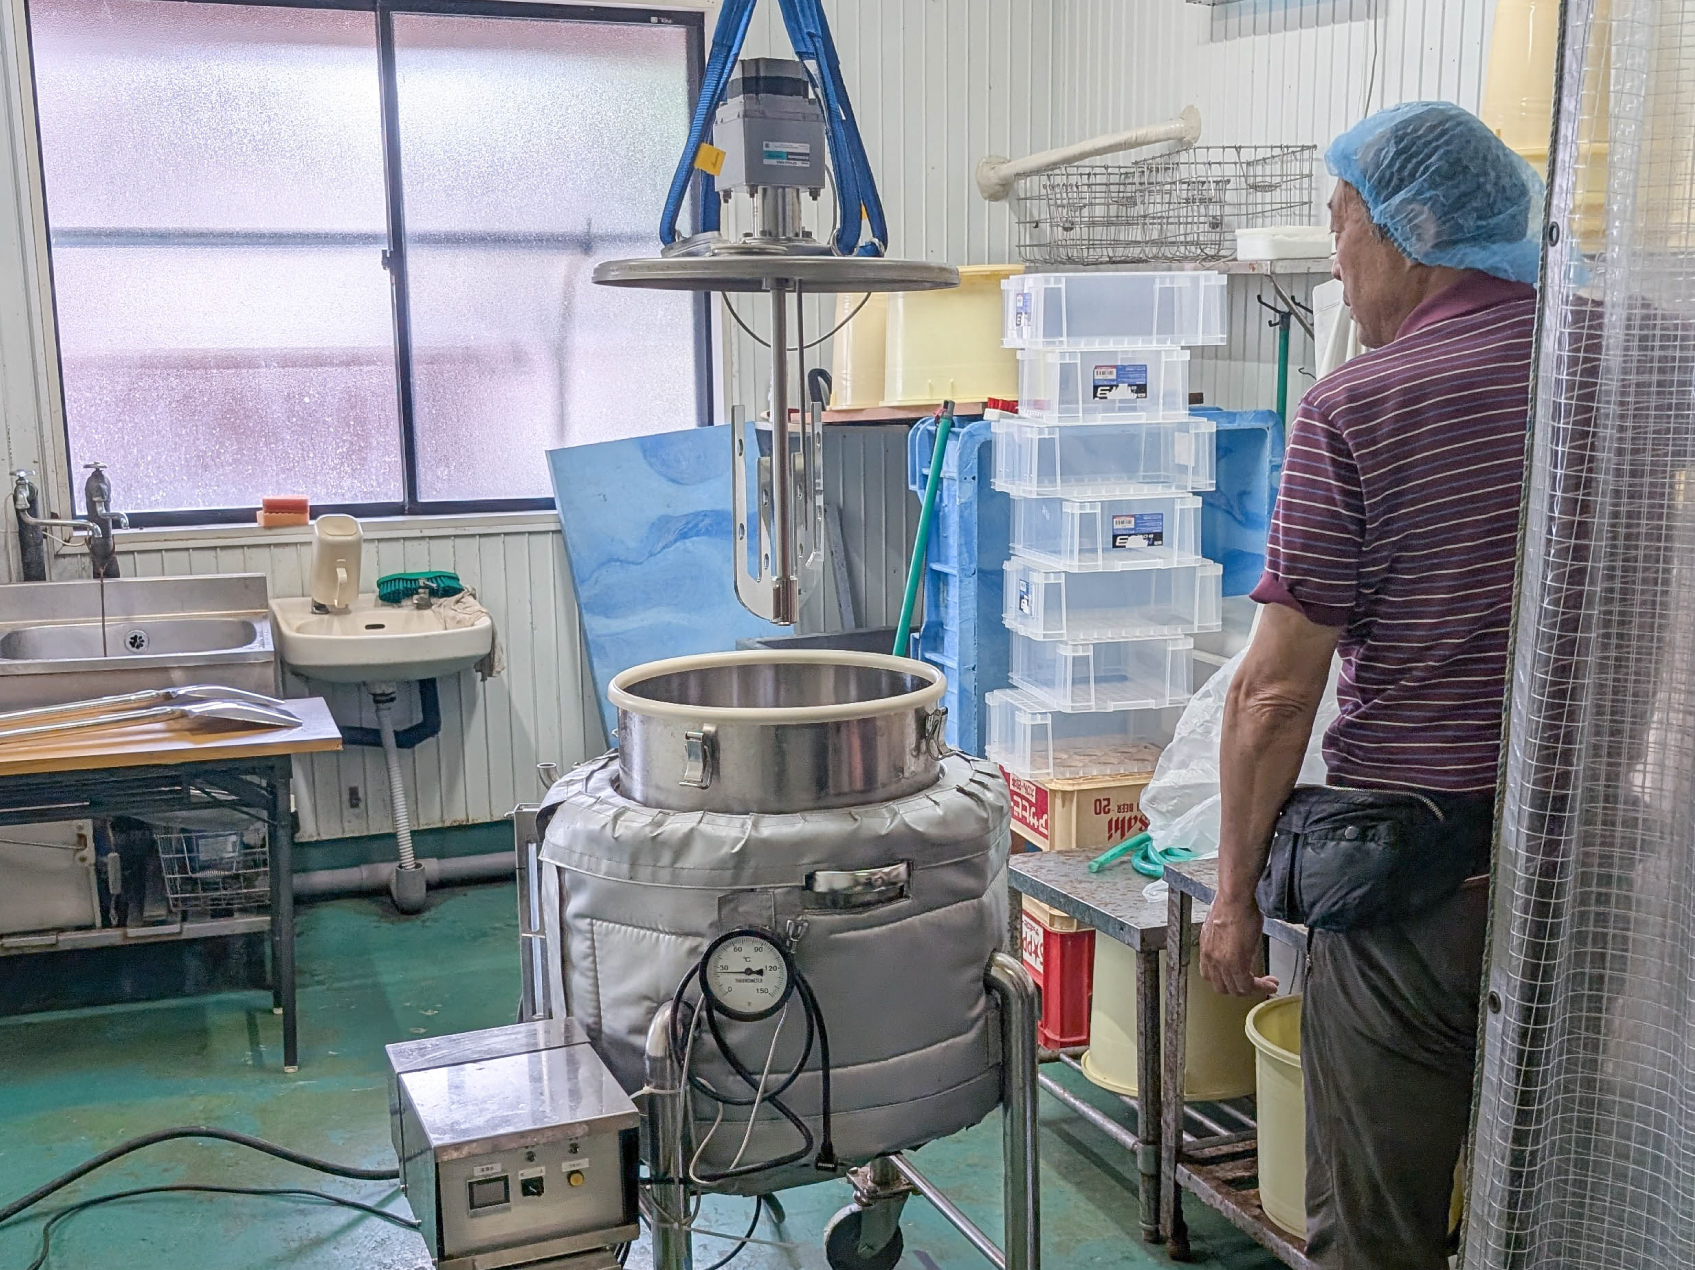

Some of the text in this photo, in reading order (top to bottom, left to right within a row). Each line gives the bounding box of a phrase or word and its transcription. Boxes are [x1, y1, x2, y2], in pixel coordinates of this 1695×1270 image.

[1011, 795, 1048, 835] アサヒビ
[1094, 797, 1111, 816] 20
[1116, 802, 1134, 815] BEER
[1107, 814, 1150, 841] sahi
